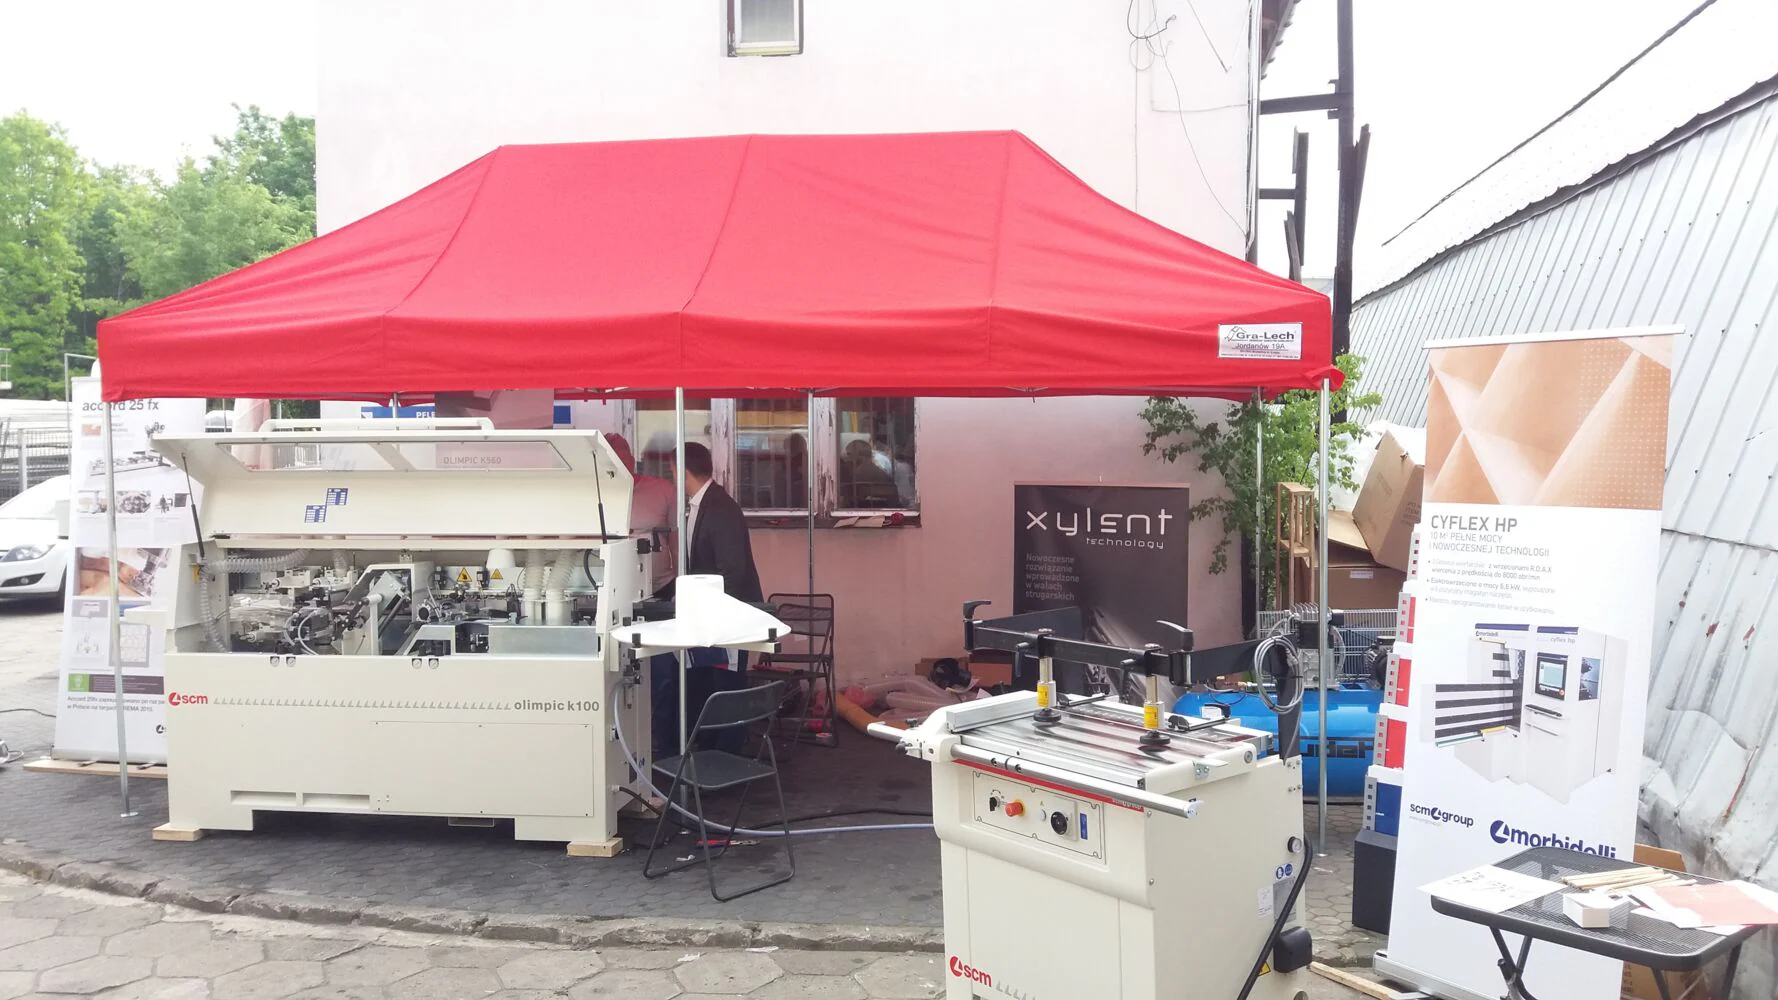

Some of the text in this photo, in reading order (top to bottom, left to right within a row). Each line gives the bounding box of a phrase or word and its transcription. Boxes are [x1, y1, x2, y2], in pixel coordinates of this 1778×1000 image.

[1236, 331, 1294, 340] Gra-Lech
[82, 399, 159, 411] accrd 25 fx
[443, 456, 479, 465] OLIMPIC
[1431, 515, 1489, 531] CYFLEX
[1495, 517, 1518, 532] HP
[1086, 537, 1164, 549] technology
[1479, 534, 1503, 543] MOCY
[1432, 542, 1493, 553] NOWOCZESNEJ
[1496, 545, 1550, 557] TECHNOLOGII
[182, 695, 208, 705] scm
[514, 700, 600, 712] olimpic k100
[1409, 803, 1431, 816] scm
[1441, 809, 1474, 828] group
[963, 964, 992, 988] scm
